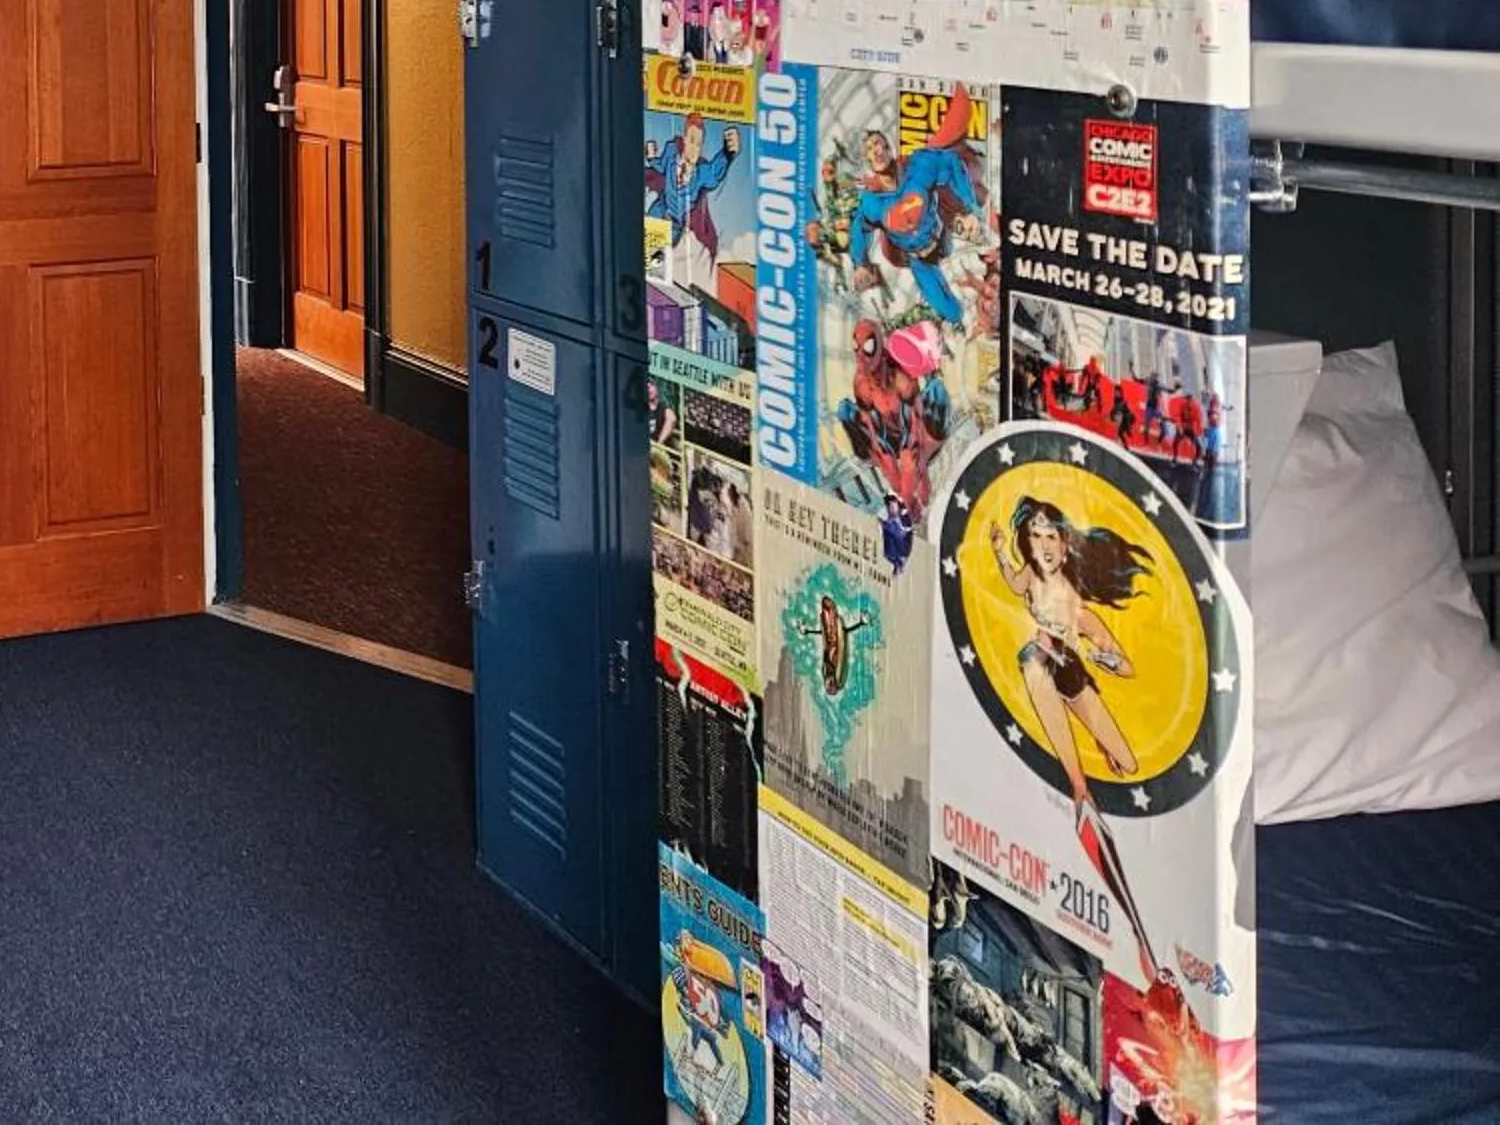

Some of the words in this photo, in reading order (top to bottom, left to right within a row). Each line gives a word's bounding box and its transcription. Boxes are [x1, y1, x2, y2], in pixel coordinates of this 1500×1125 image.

[656, 58, 745, 105] Conan
[758, 72, 798, 147] 50
[929, 96, 988, 141] CN
[1089, 136, 1153, 160] COMIC
[1091, 162, 1152, 187] EXPO
[1087, 183, 1153, 216] C2E2
[474, 240, 492, 291] 1
[1008, 218, 1079, 257] SAVE
[1086, 232, 1148, 269] THE
[1155, 245, 1245, 284] DATE
[618, 272, 642, 332] 3
[757, 155, 798, 469] COMIC-CON
[1015, 257, 1090, 292] MARCH
[1094, 275, 1173, 314] 26-28,
[1176, 291, 1236, 321] 2021
[478, 317, 499, 370] 2
[622, 364, 644, 424] 4
[672, 358, 709, 385] SEATTLE
[821, 514, 878, 565] THERE!
[942, 803, 1049, 898] COMIC-CON
[1059, 871, 1110, 934] 2016
[707, 898, 764, 956] GUIDE
